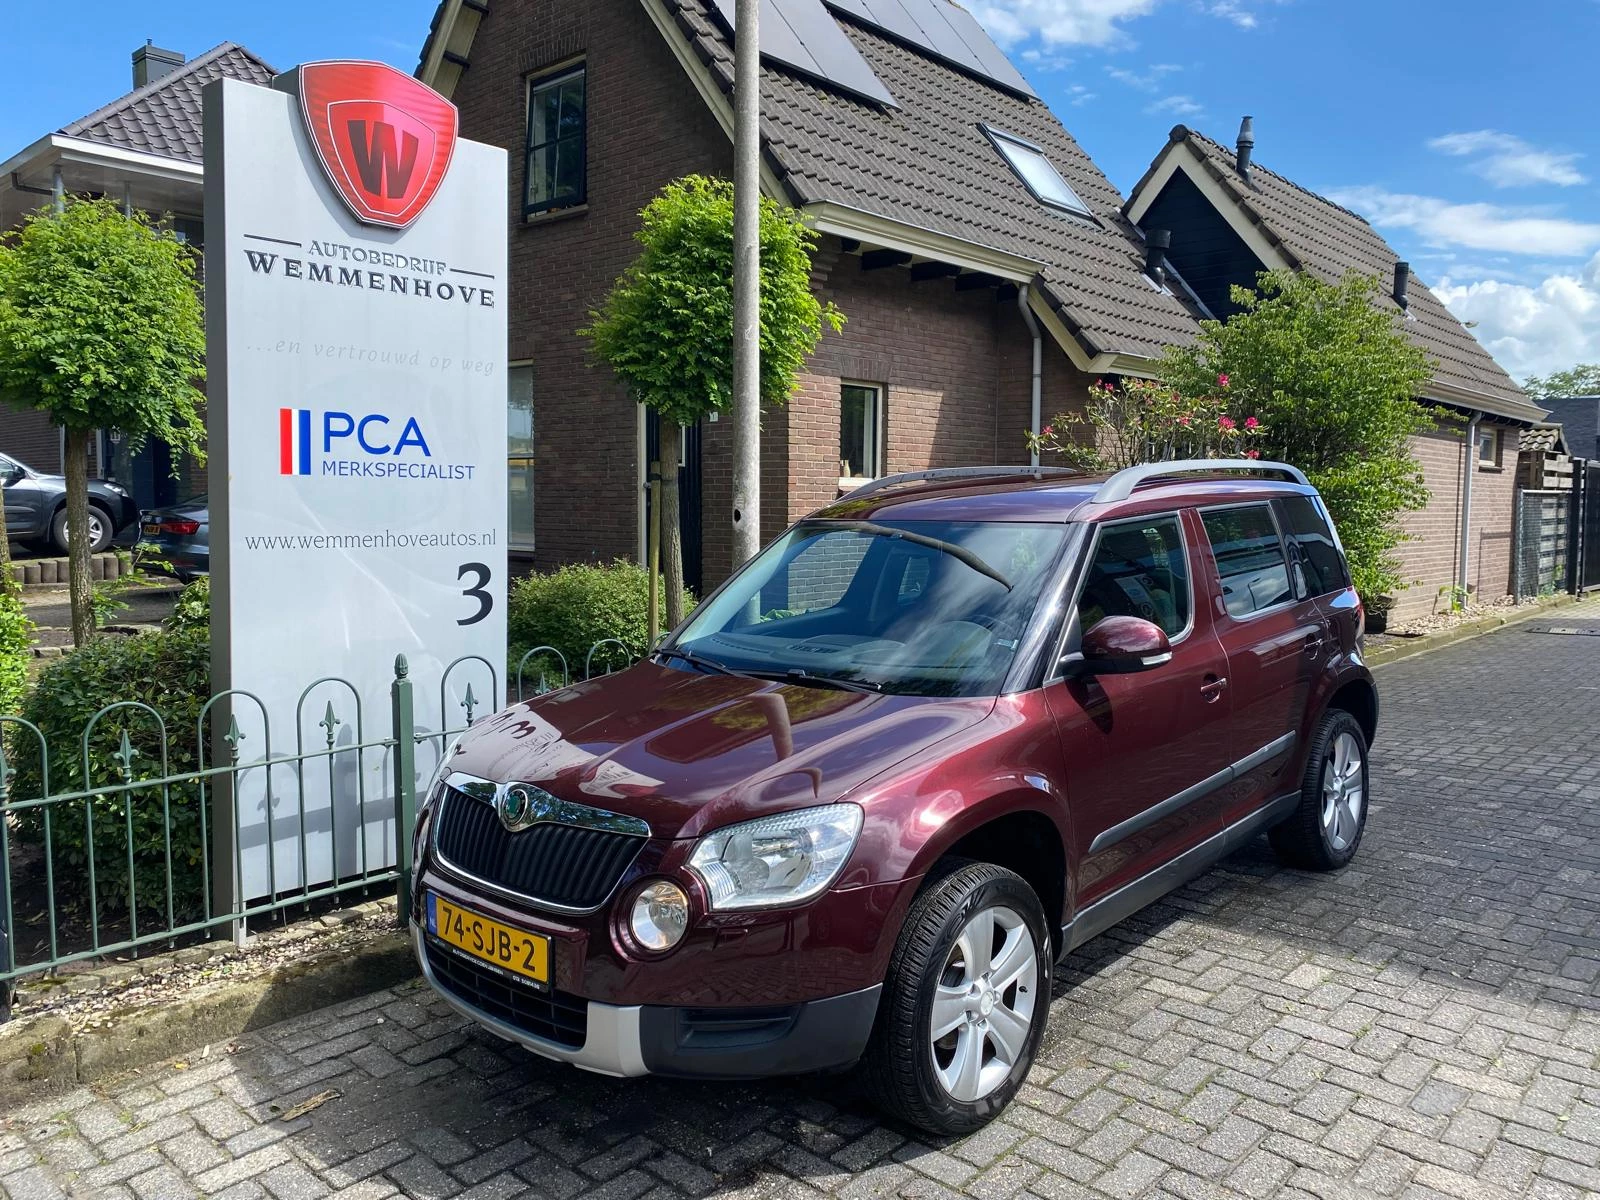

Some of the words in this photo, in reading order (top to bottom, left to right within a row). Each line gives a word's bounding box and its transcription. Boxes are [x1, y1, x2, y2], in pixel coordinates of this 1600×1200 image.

[347, 119, 419, 199] W
[243, 249, 495, 309] WEMMENHOVE
[308, 240, 447, 276] AUTOBEDRIJF
[313, 342, 420, 366] vertrouwd
[430, 355, 452, 371] op
[461, 358, 495, 377] weg
[323, 411, 432, 457] PCA
[322, 460, 475, 480] MERKSPECIALIST
[245, 529, 496, 551] www.wemmenhoveautos.nl
[456, 562, 494, 626] 3
[442, 906, 536, 972] 74-SJB-2
